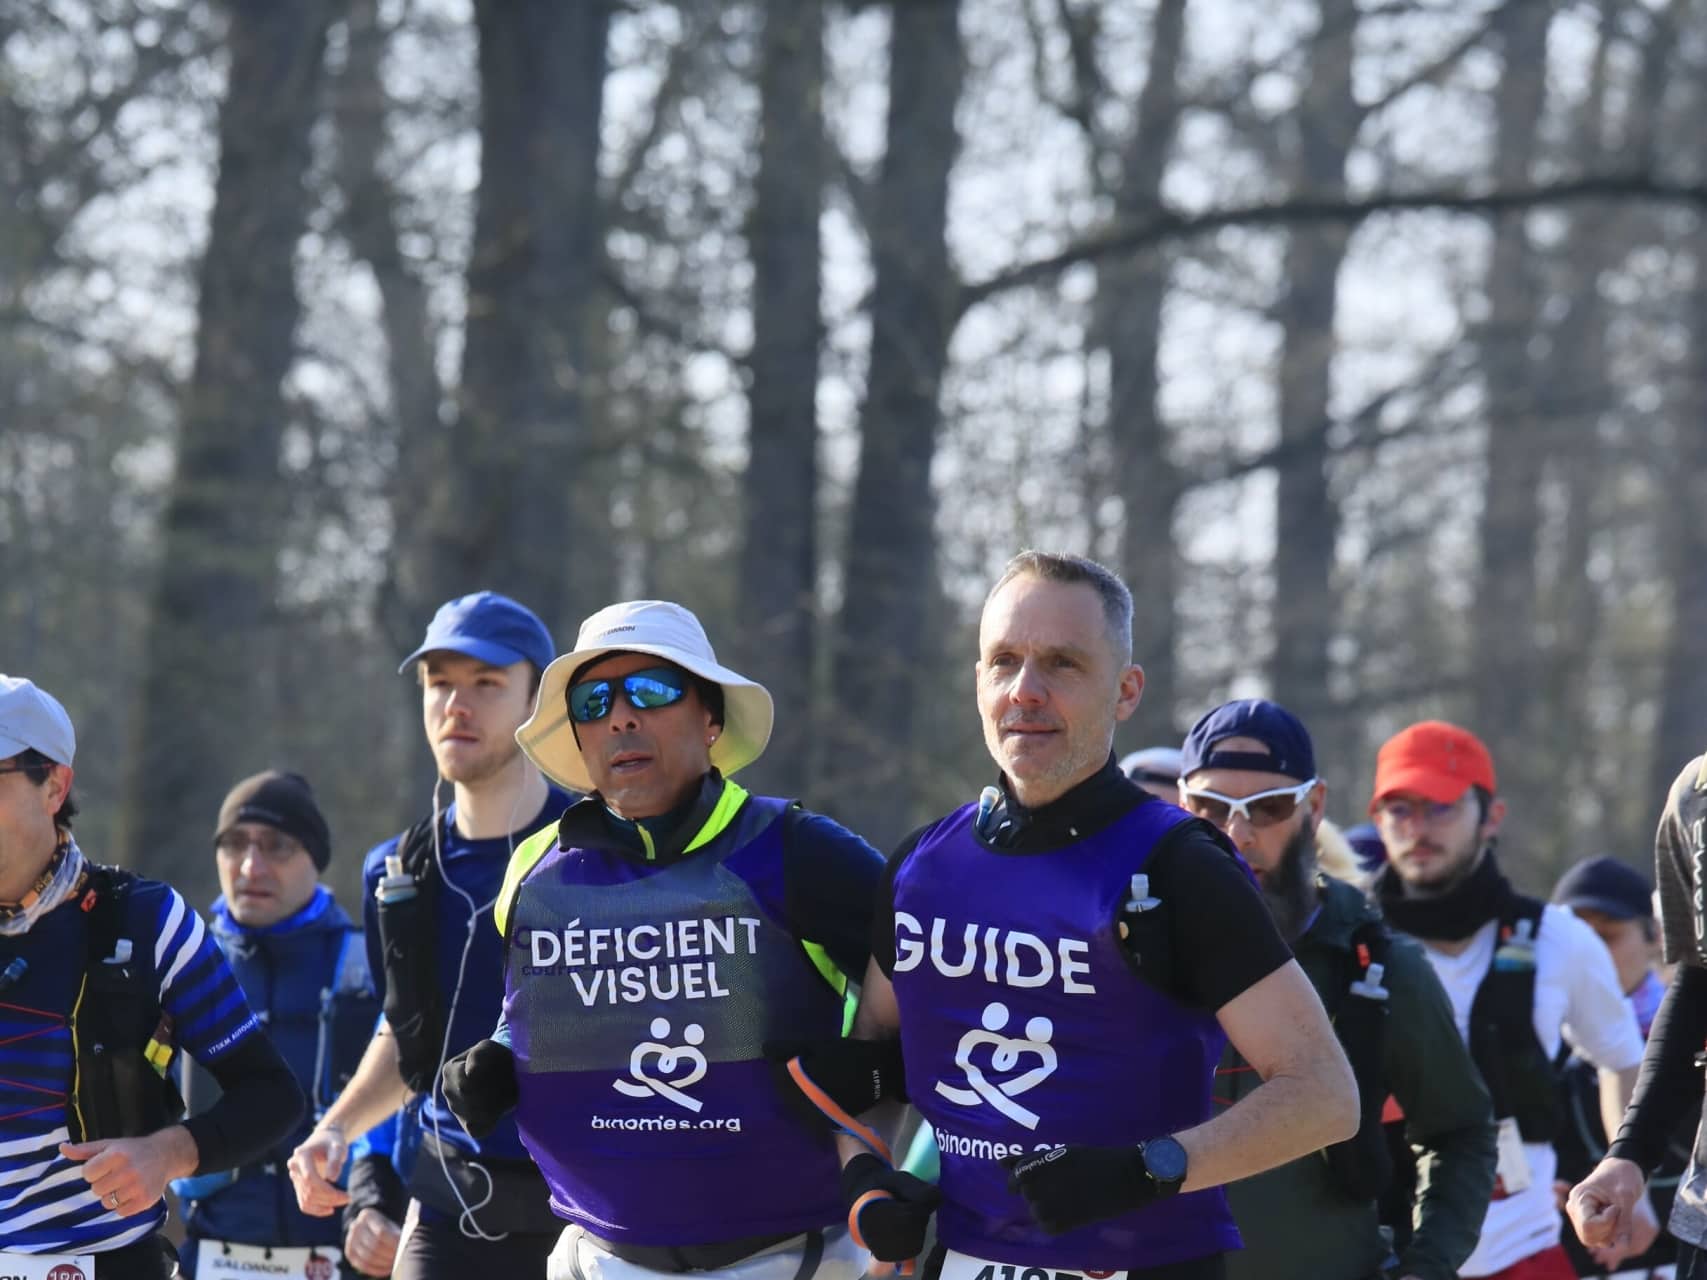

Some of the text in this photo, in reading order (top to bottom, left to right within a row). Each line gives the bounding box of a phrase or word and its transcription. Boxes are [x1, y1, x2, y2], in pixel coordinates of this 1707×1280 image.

[530, 917, 761, 967] DÉFICIENT
[894, 912, 1097, 995] GUIDE
[570, 961, 730, 1007] VISUEL
